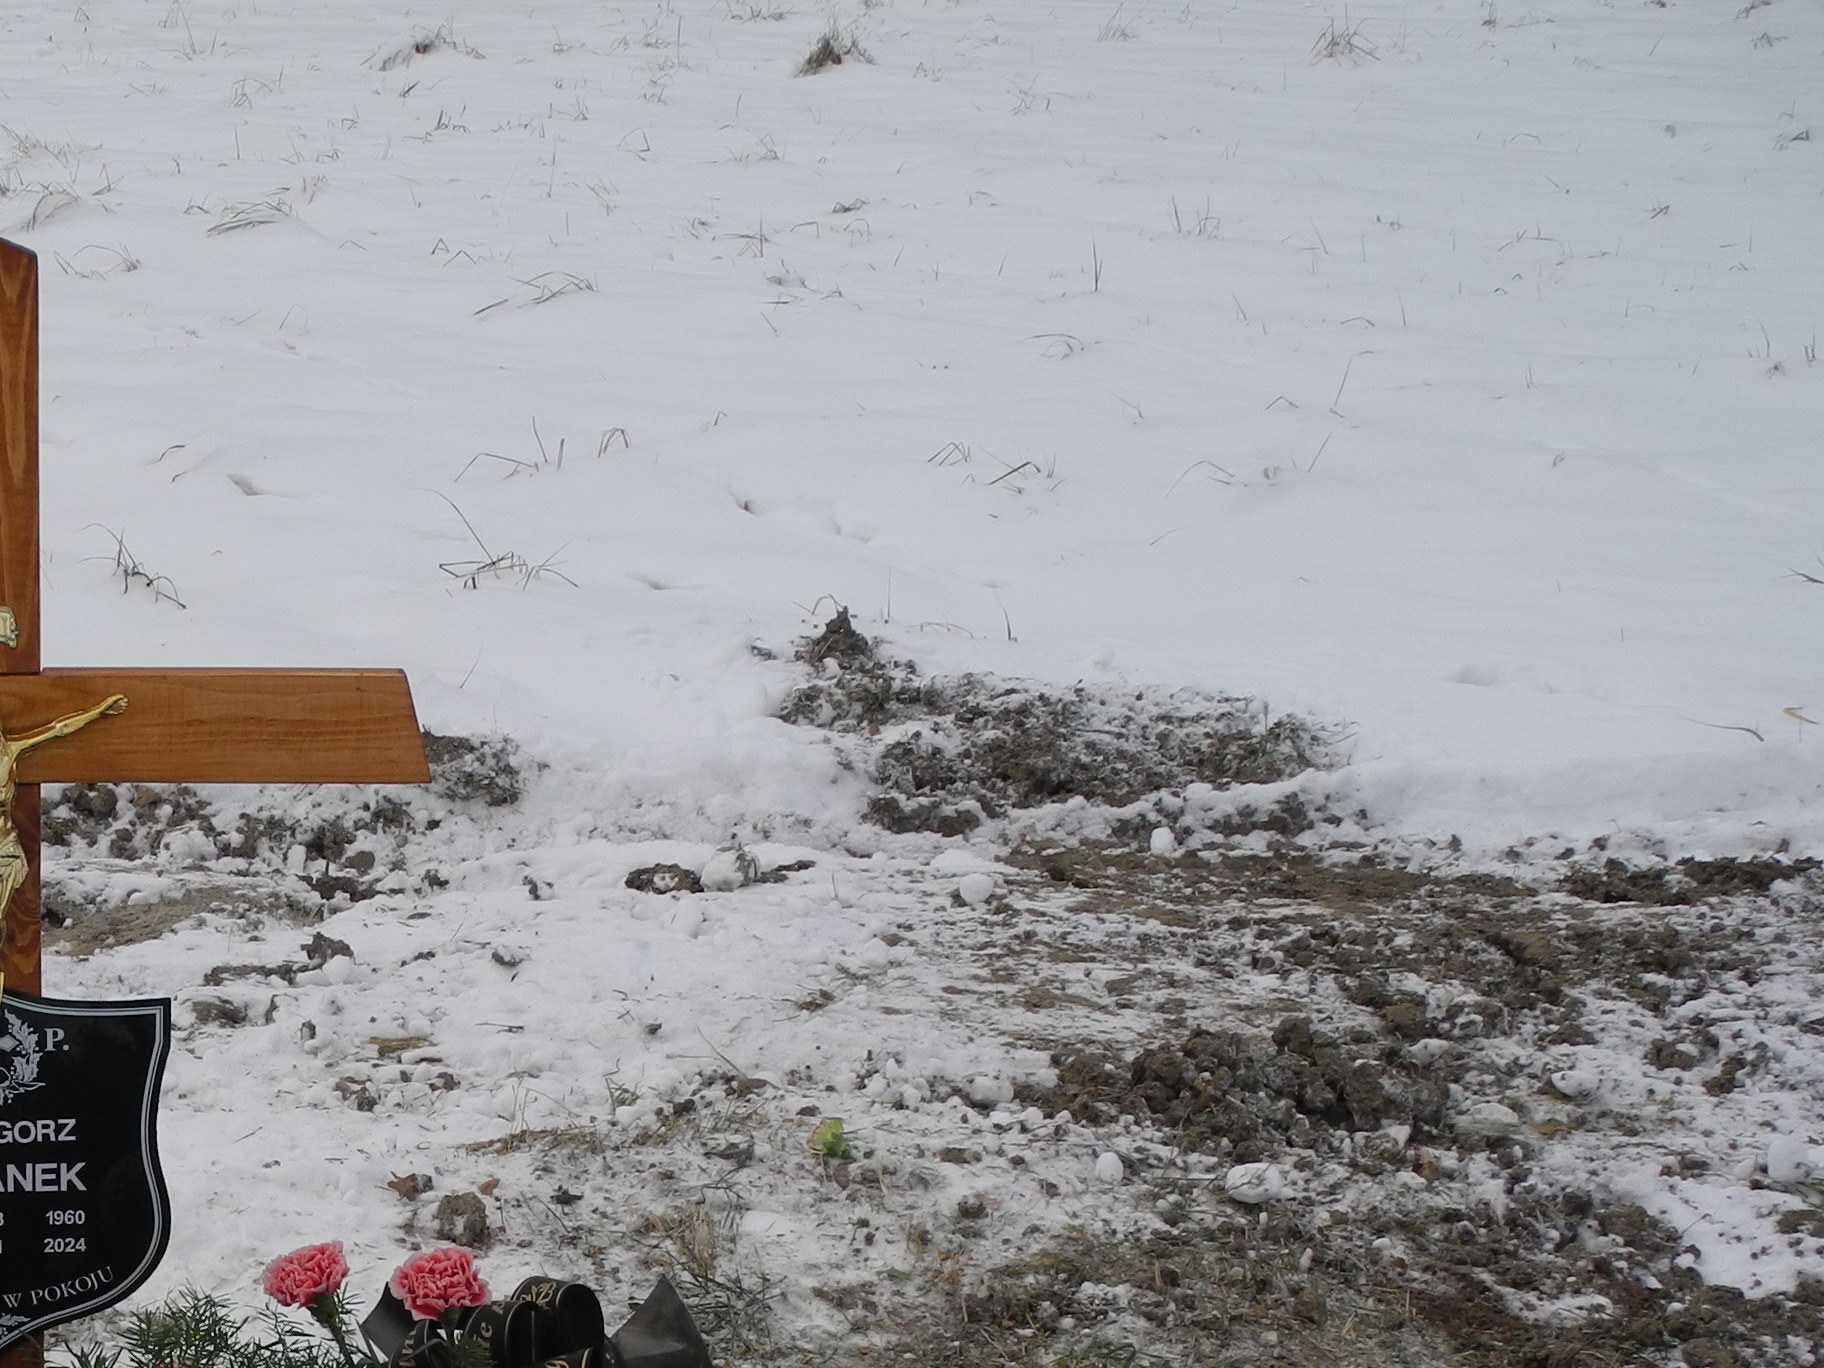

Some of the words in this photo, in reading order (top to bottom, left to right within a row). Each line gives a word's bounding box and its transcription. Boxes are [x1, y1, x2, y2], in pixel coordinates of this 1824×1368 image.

[44, 1028, 70, 1053] P.
[45, 1210, 86, 1226] 1960
[43, 1237, 87, 1253] 2024
[2, 1292, 23, 1310] W
[31, 1265, 115, 1306] POKOJU
